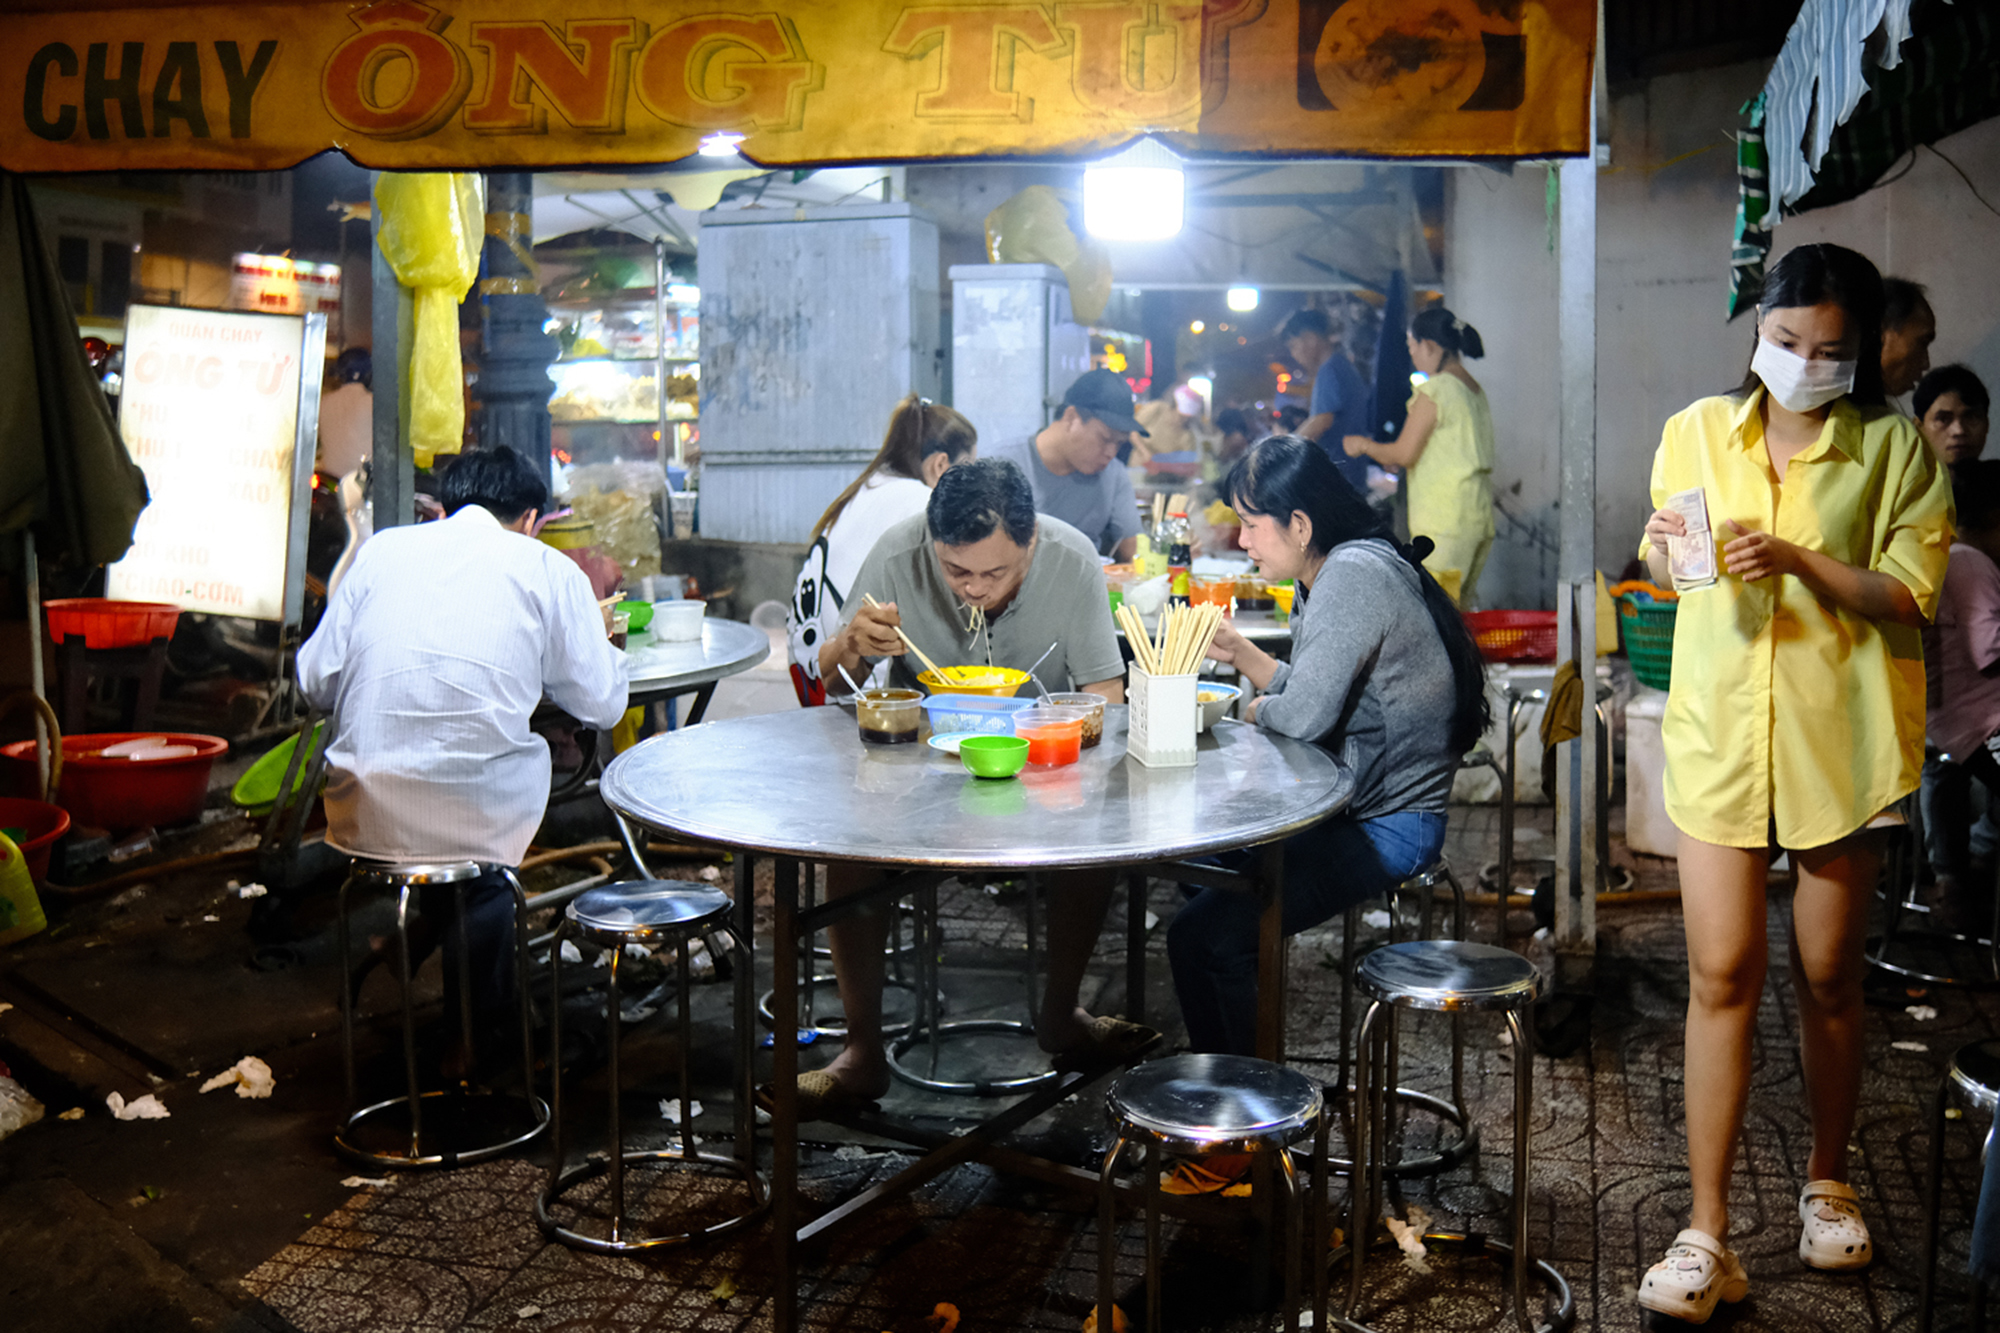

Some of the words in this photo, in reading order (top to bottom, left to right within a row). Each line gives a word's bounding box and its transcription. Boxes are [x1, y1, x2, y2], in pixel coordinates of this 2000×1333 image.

[24, 40, 280, 142] CHAY
[320, 0, 826, 142] ÔNG
[219, 326, 264, 343] CHAY
[133, 340, 225, 391] ÔNG
